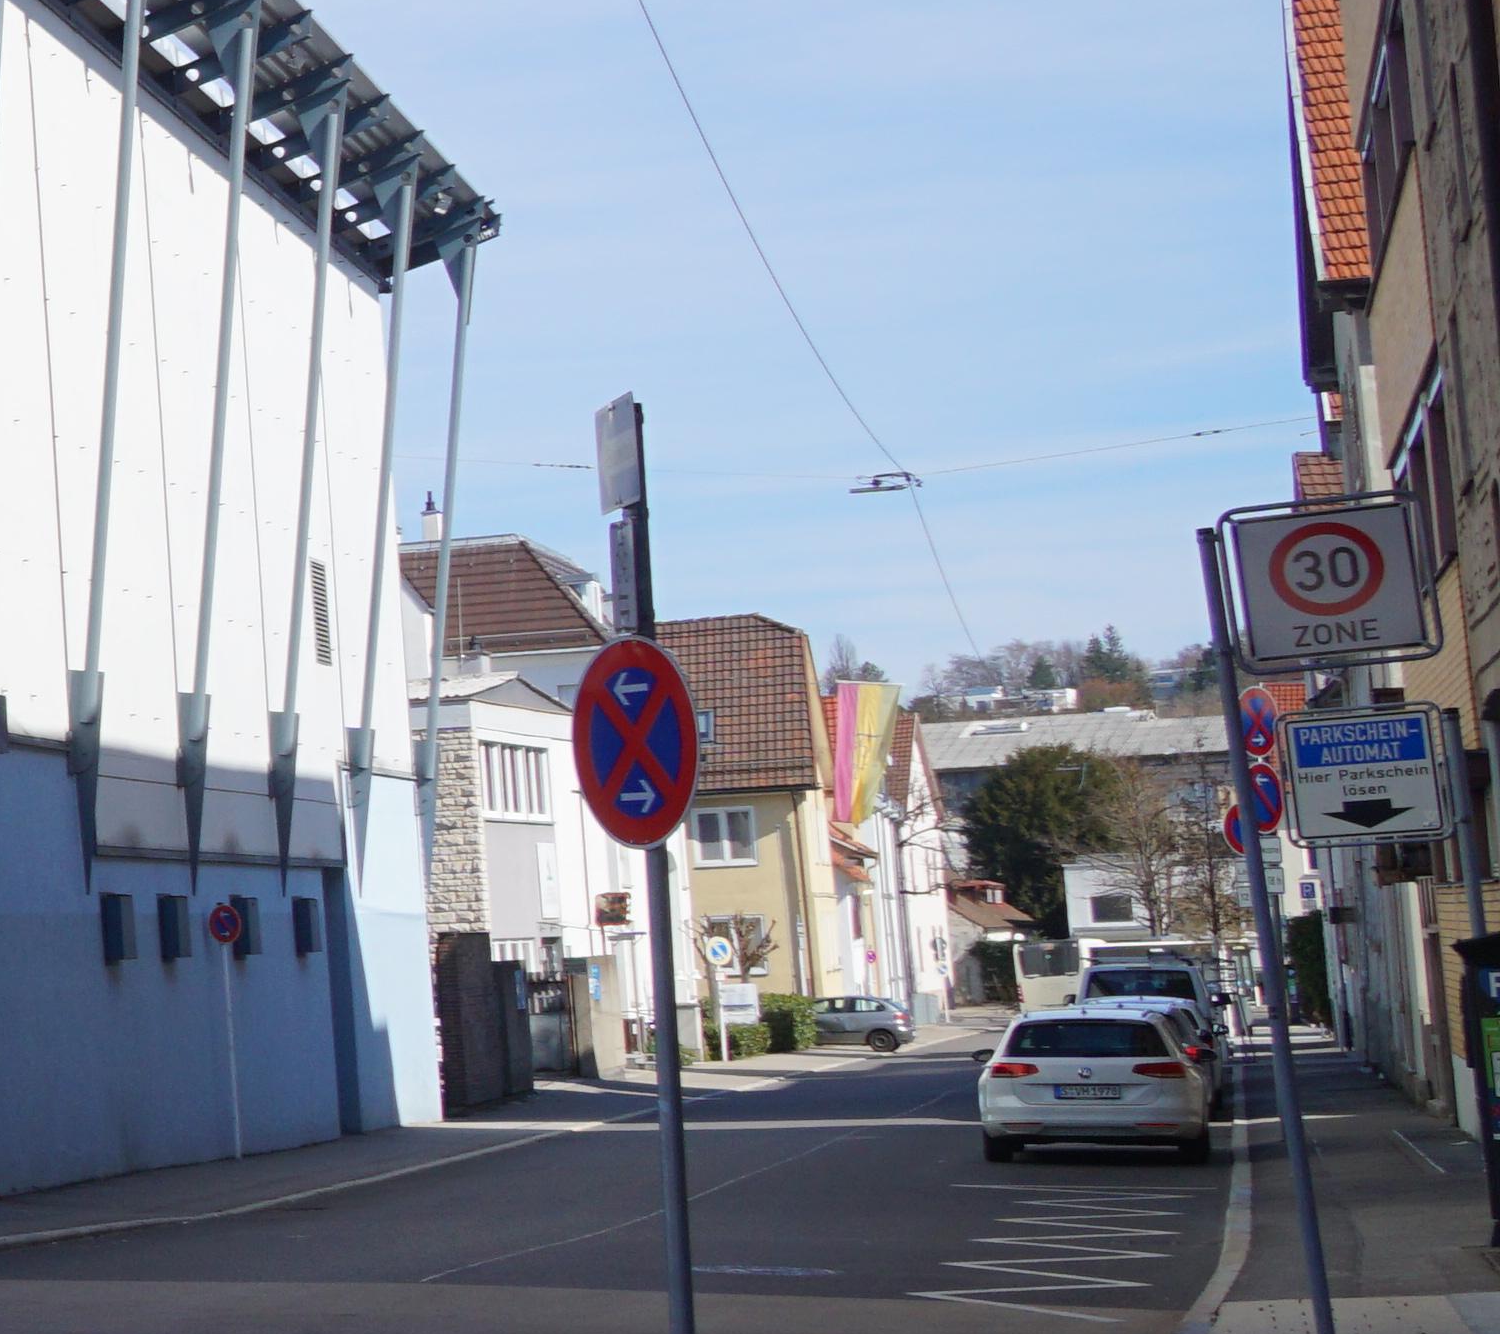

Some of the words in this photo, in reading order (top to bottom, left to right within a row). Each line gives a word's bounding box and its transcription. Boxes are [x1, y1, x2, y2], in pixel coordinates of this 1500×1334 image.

[1293, 546, 1360, 592] 30
[1293, 618, 1381, 648] ZONE
[1299, 720, 1420, 746] PARKSCHEIN-
[1320, 741, 1402, 765] AUTOMAT
[1298, 771, 1332, 784] Hier
[1339, 765, 1429, 781] Parkschein
[1343, 783, 1388, 797] lösen
